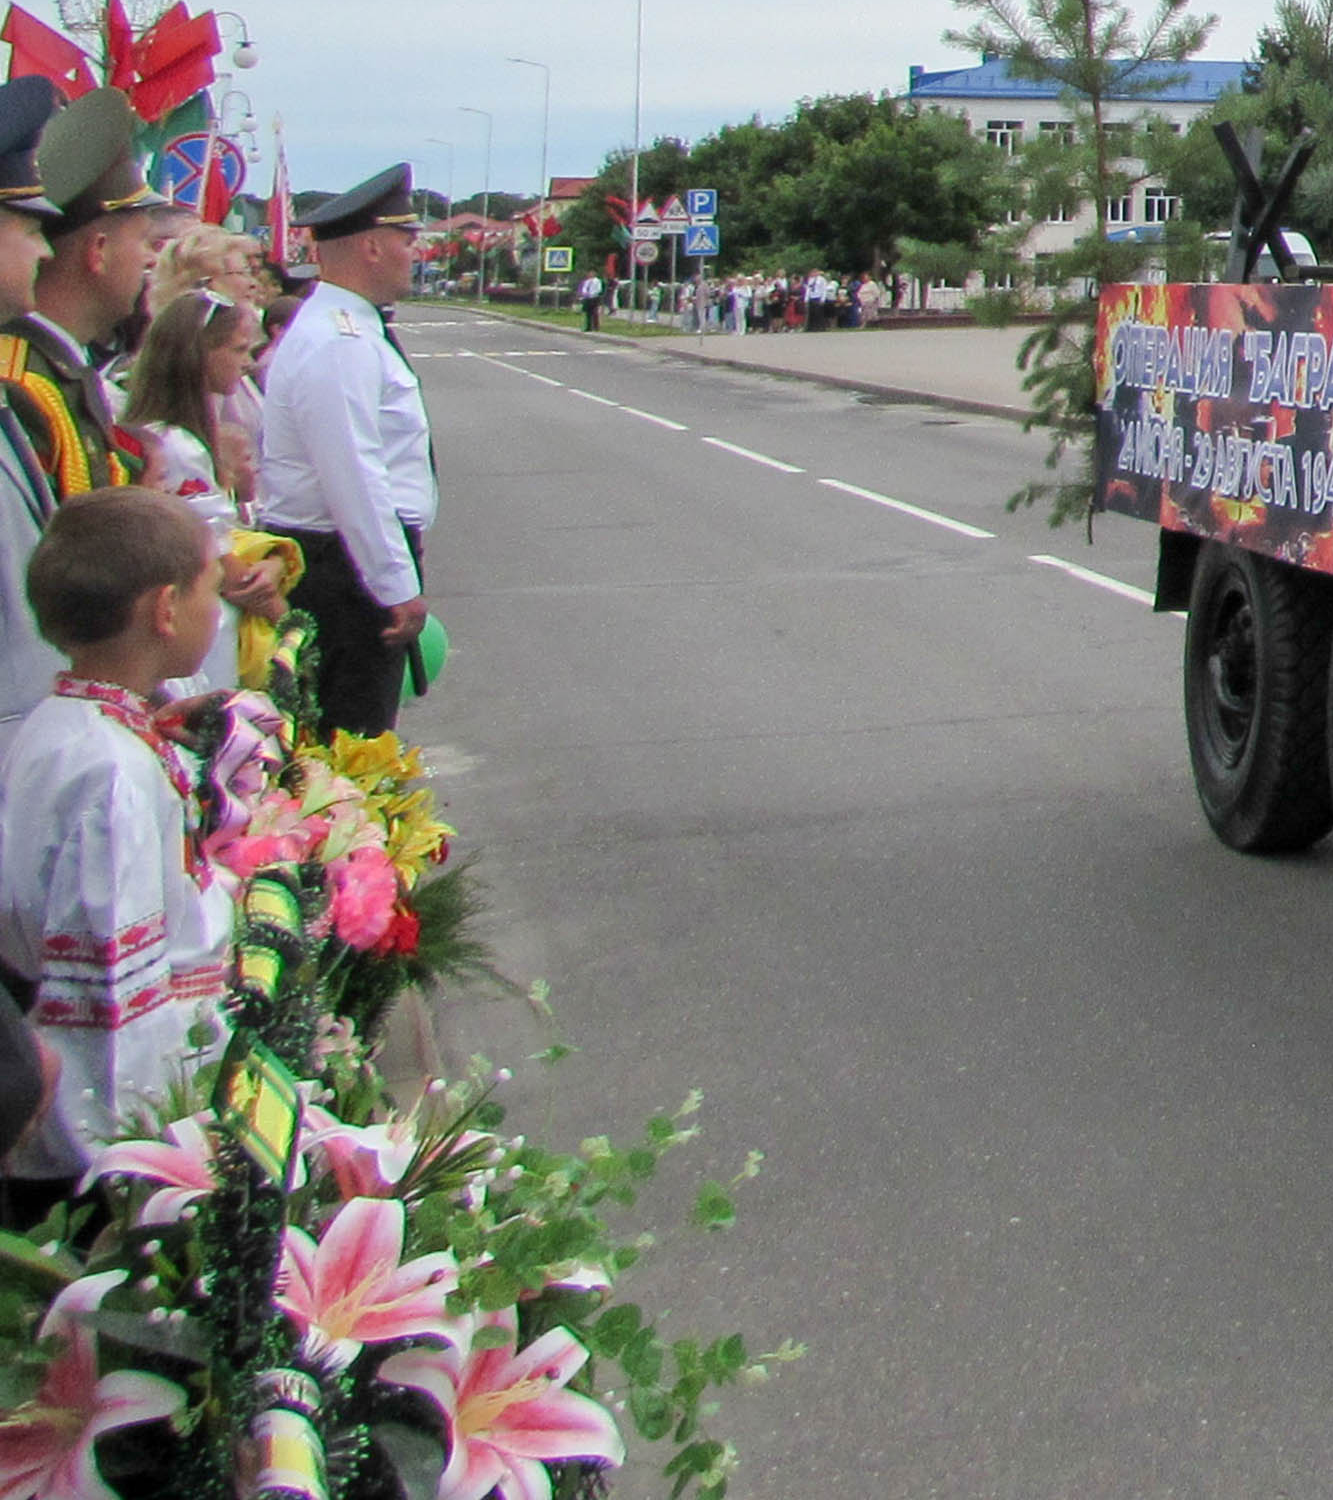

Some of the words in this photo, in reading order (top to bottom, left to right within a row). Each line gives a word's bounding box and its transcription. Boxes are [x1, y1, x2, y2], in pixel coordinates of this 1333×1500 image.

[694, 192, 710, 213] P
[1112, 323, 1234, 401] ОПЕРАЦИЯ
[1211, 433, 1298, 510] АВГУСТА
